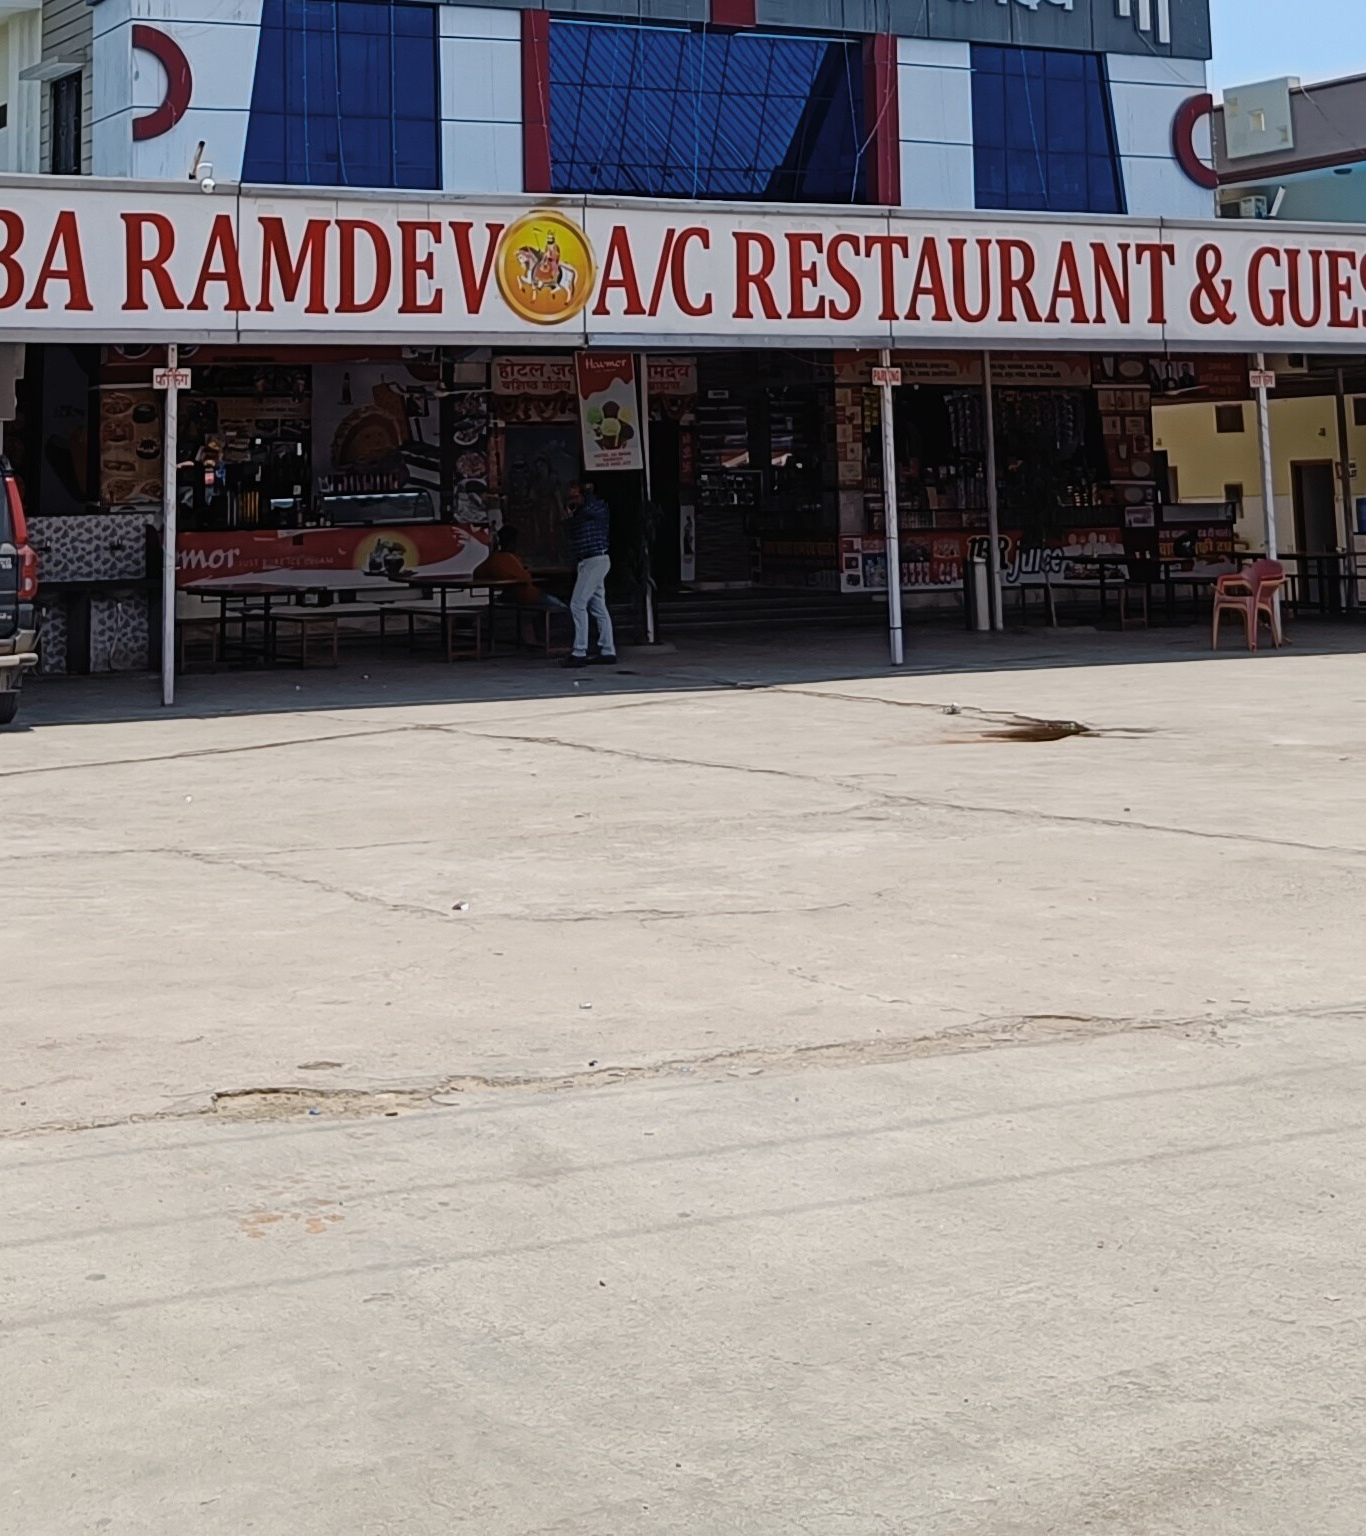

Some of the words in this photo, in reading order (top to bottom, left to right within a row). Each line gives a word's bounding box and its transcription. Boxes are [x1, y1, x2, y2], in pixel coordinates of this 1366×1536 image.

[123, 213, 505, 315] RAMDEV
[592, 225, 714, 318] A/C
[732, 231, 1175, 324] RESTAURANT
[1189, 243, 1236, 325] &
[496, 359, 545, 378] होटल
